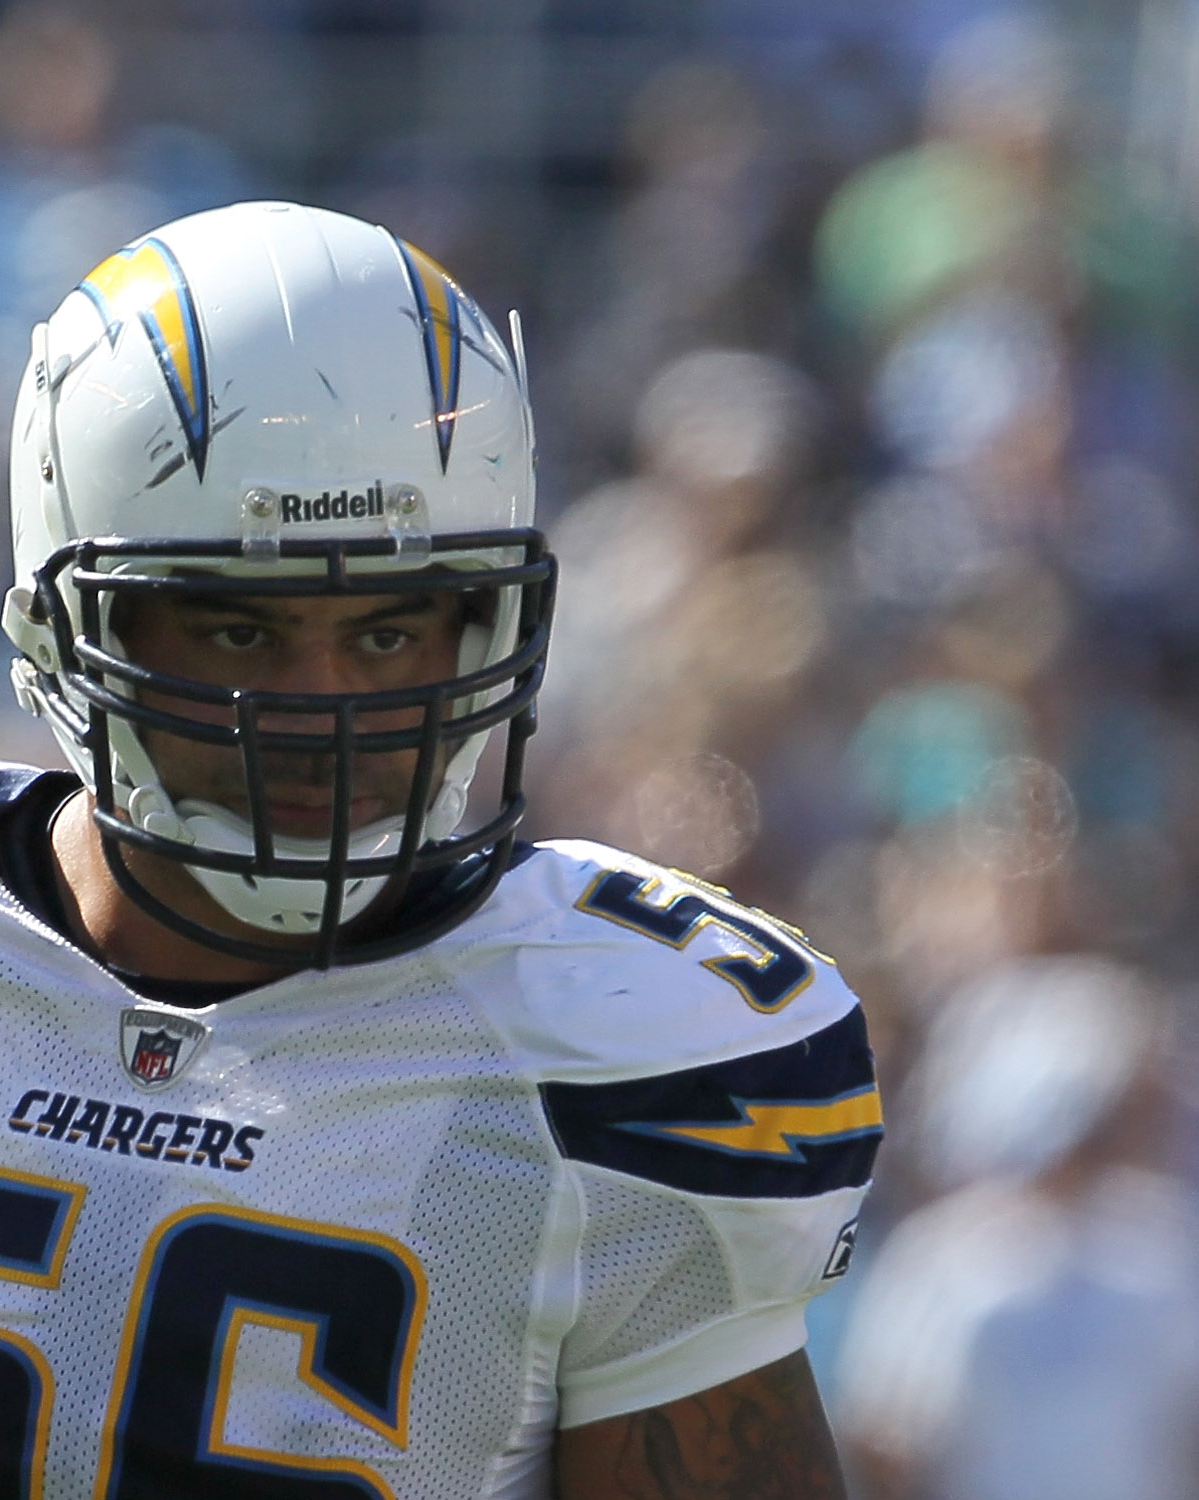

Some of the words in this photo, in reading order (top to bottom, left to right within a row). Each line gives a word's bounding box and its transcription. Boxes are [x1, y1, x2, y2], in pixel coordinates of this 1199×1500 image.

[280, 480, 385, 523] Riddell
[574, 867, 837, 1014] 5
[134, 1050, 173, 1080] NFL
[8, 1089, 265, 1172] CHARGERS
